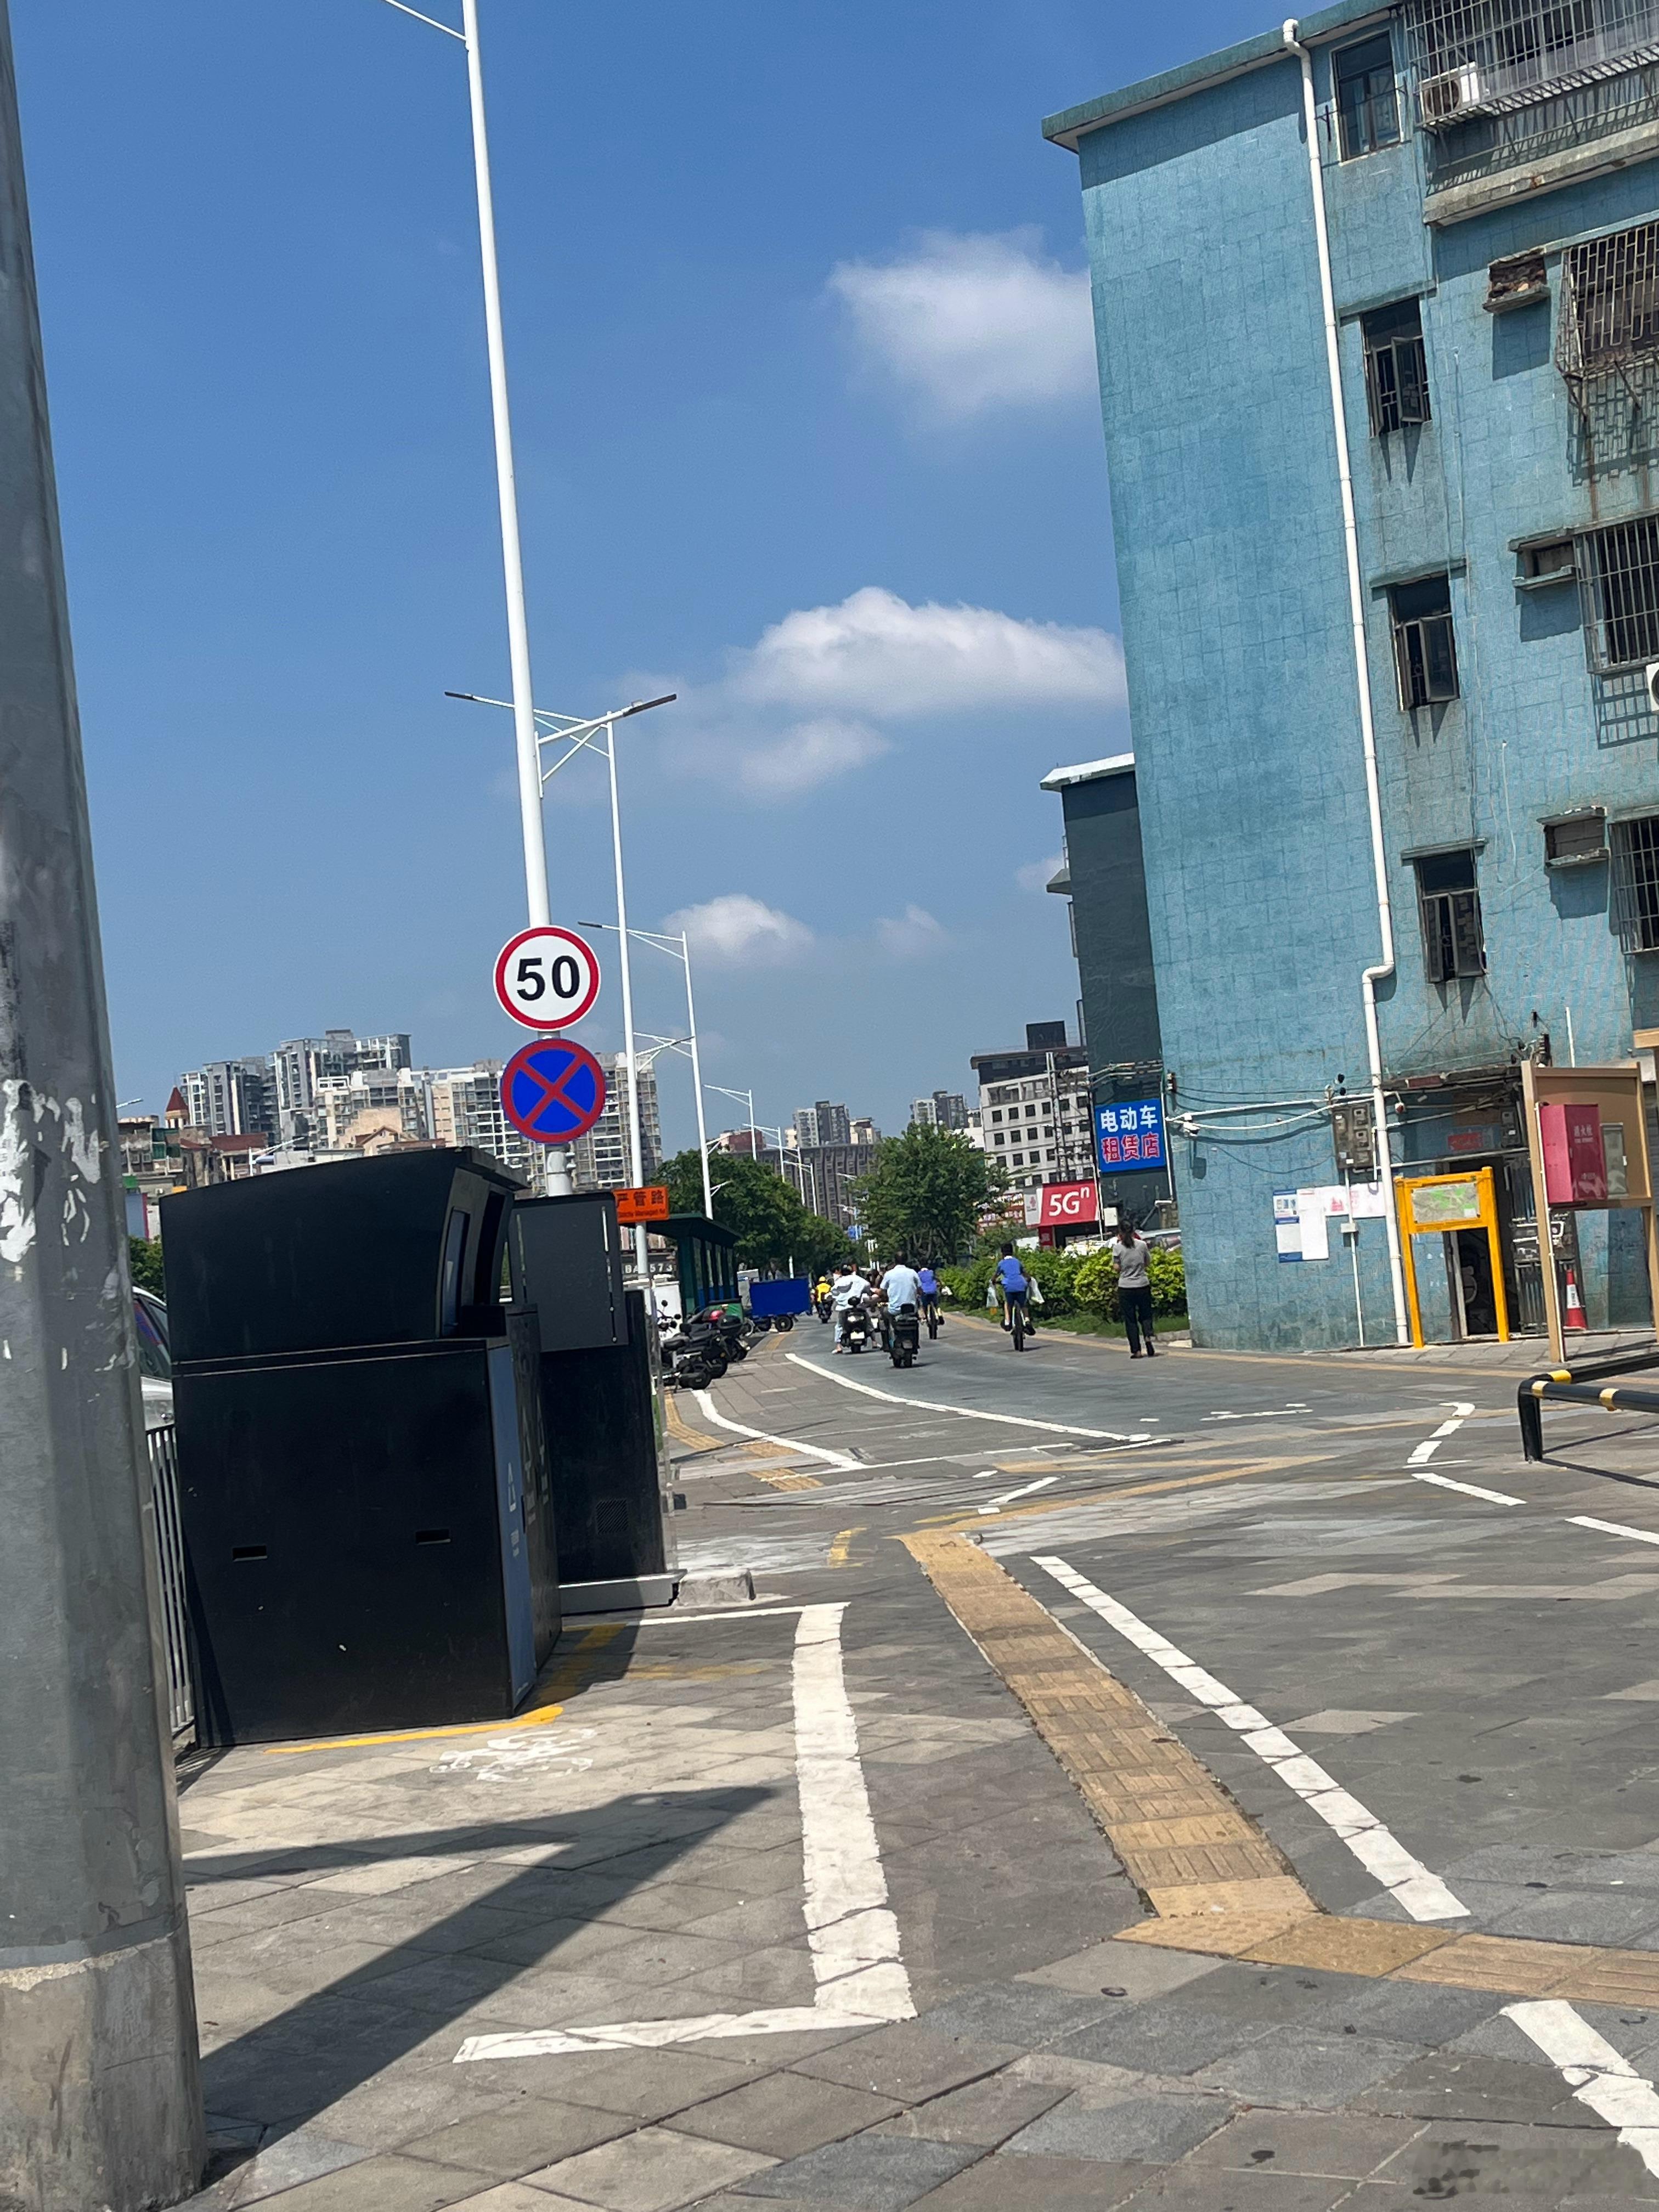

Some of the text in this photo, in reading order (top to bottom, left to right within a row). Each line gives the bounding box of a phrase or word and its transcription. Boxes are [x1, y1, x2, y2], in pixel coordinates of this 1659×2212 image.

[516, 955, 580, 1001] 50
[1100, 1104, 1158, 1133] 电动车
[1101, 1131, 1160, 1164] 租赁店
